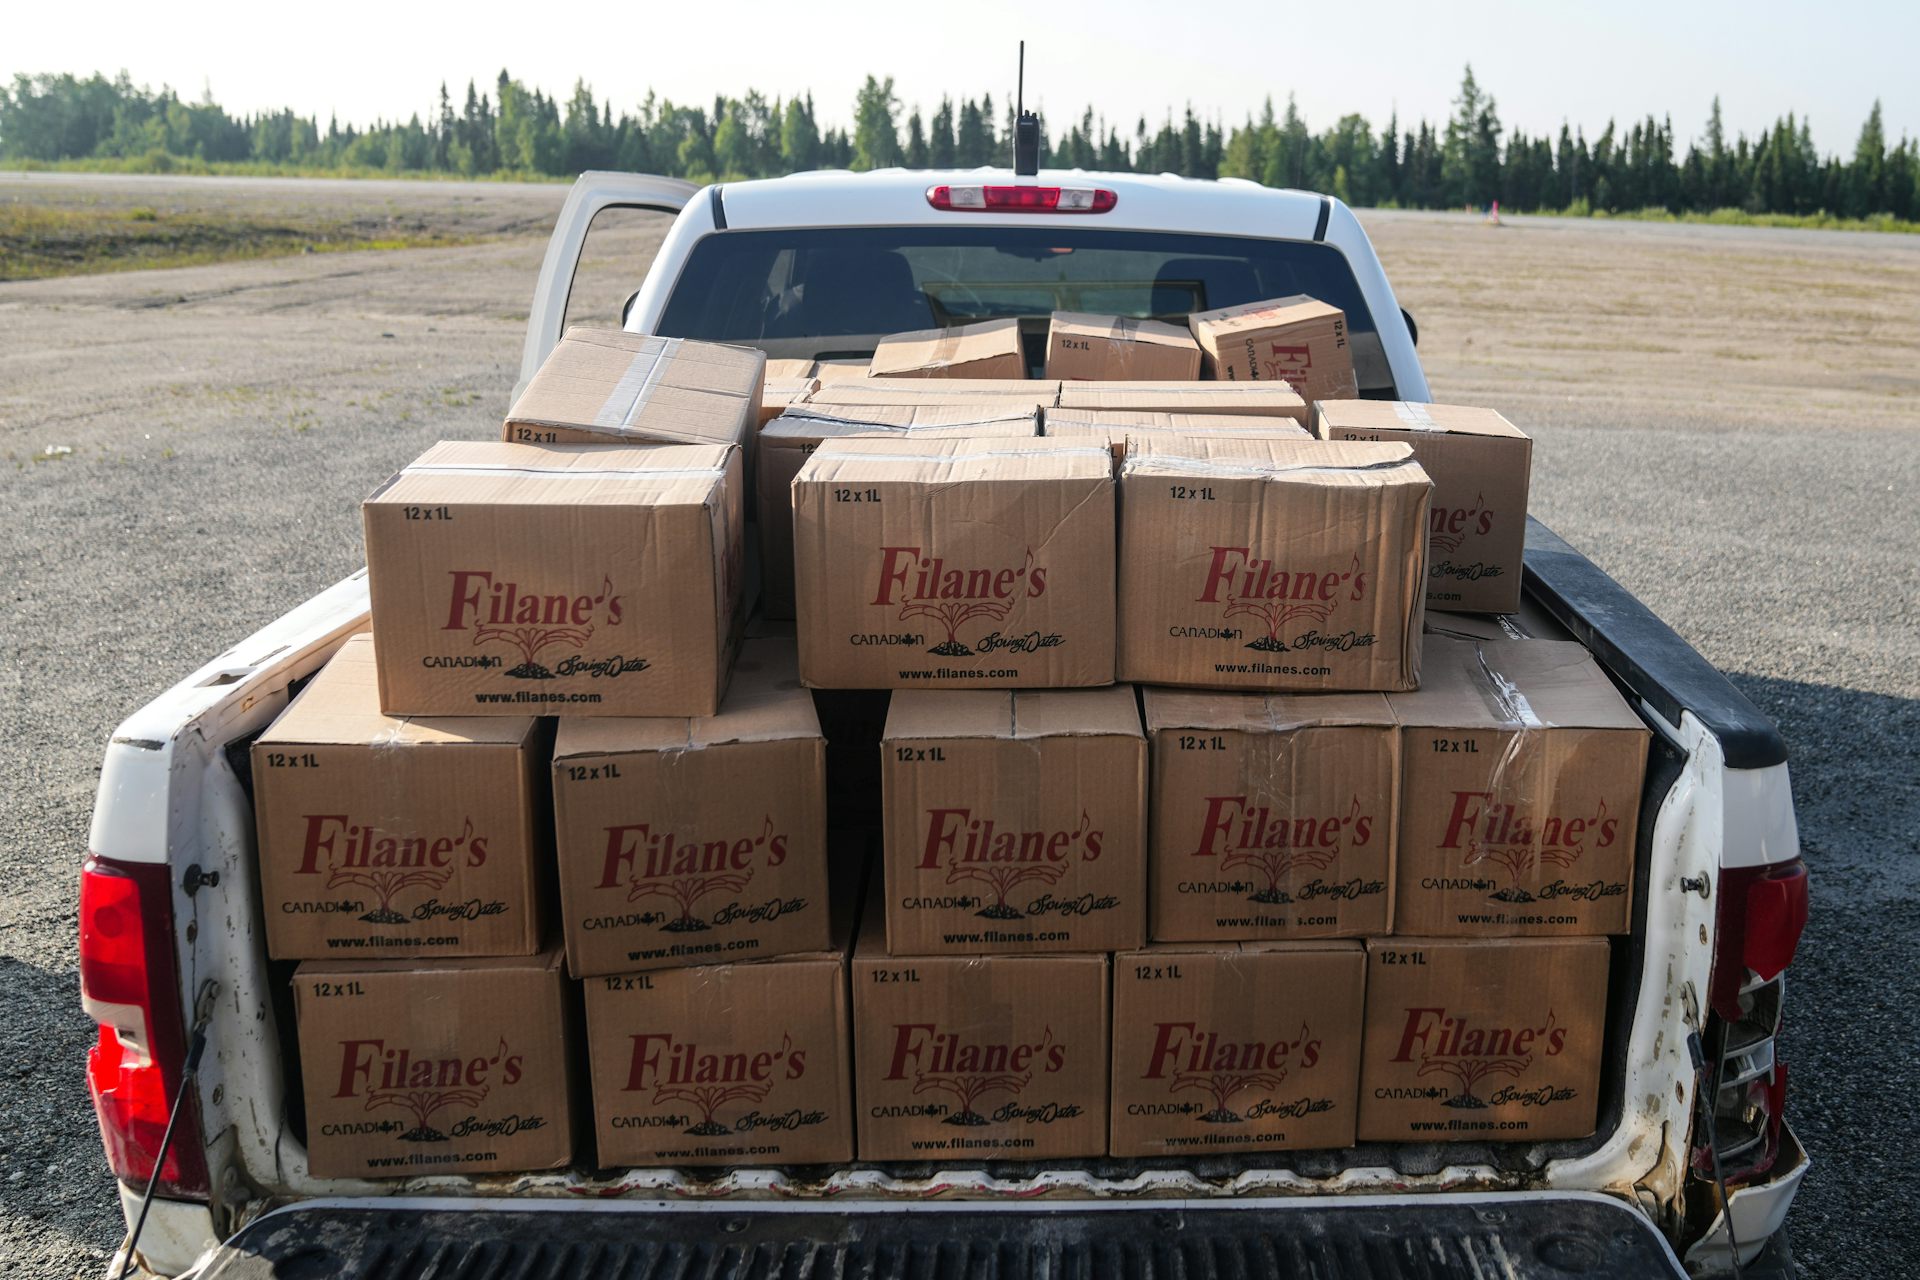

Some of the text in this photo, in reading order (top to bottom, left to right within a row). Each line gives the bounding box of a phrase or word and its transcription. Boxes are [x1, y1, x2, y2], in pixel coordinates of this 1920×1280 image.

[1334, 320, 1343, 329] 12
[1062, 340, 1071, 348] 12
[1081, 341, 1090, 351] 1L
[1336, 339, 1345, 349] 1L
[517, 428, 531, 440] 12
[834, 490, 851, 502] 12
[865, 490, 881, 502] 1L
[1170, 487, 1186, 499] 12
[1200, 488, 1215, 500] 1L
[404, 508, 420, 520] 12
[436, 508, 452, 520] 1L
[1430, 490, 1494, 535] ne's
[870, 546, 1047, 606] Filane's
[1195, 546, 1371, 603] Filane's
[441, 571, 624, 630] Filane's
[899, 668, 1018, 679] www.filanes.com
[1214, 663, 1331, 675] www.filanes.com
[476, 692, 601, 703] www.filanes.com
[1179, 736, 1195, 750] 12
[1211, 736, 1226, 750] 1L
[1433, 740, 1448, 752] 12
[1463, 740, 1478, 753] 1L
[267, 754, 285, 767] 12
[302, 754, 319, 768] 1L
[896, 748, 913, 761] 12
[930, 747, 945, 761] 1L
[568, 766, 587, 781] 12
[602, 764, 621, 778] 1L
[1191, 793, 1373, 856] Filane's
[293, 814, 488, 874] Filane's
[914, 808, 1104, 869] Filane's
[594, 813, 788, 889] Filane's
[327, 936, 459, 948] www.filanes.com
[944, 930, 1069, 944] www.filanes.com
[628, 938, 759, 961] www.filanes.com
[1381, 952, 1397, 965] 12
[1412, 952, 1426, 965] 1L
[872, 970, 888, 983] 12
[903, 969, 920, 982] 1L
[1135, 966, 1151, 980] 12
[1166, 965, 1182, 979] 1L
[313, 983, 332, 997] 12
[346, 982, 364, 996] 1L
[605, 977, 622, 990] 12
[637, 976, 654, 990] 1L
[1389, 1007, 1567, 1063] Filane's
[882, 1024, 1066, 1081] Filane's
[1141, 1019, 1322, 1079] Filane's
[331, 1036, 523, 1098] Filane's
[621, 1031, 806, 1092] Filane's
[1411, 1120, 1528, 1131] www.filanes.com
[912, 1137, 1034, 1150] www.filanes.com
[1166, 1132, 1285, 1146] www.filanes.com
[656, 1145, 780, 1159] www.filanes.com
[367, 1151, 497, 1168] www.filanes.com
